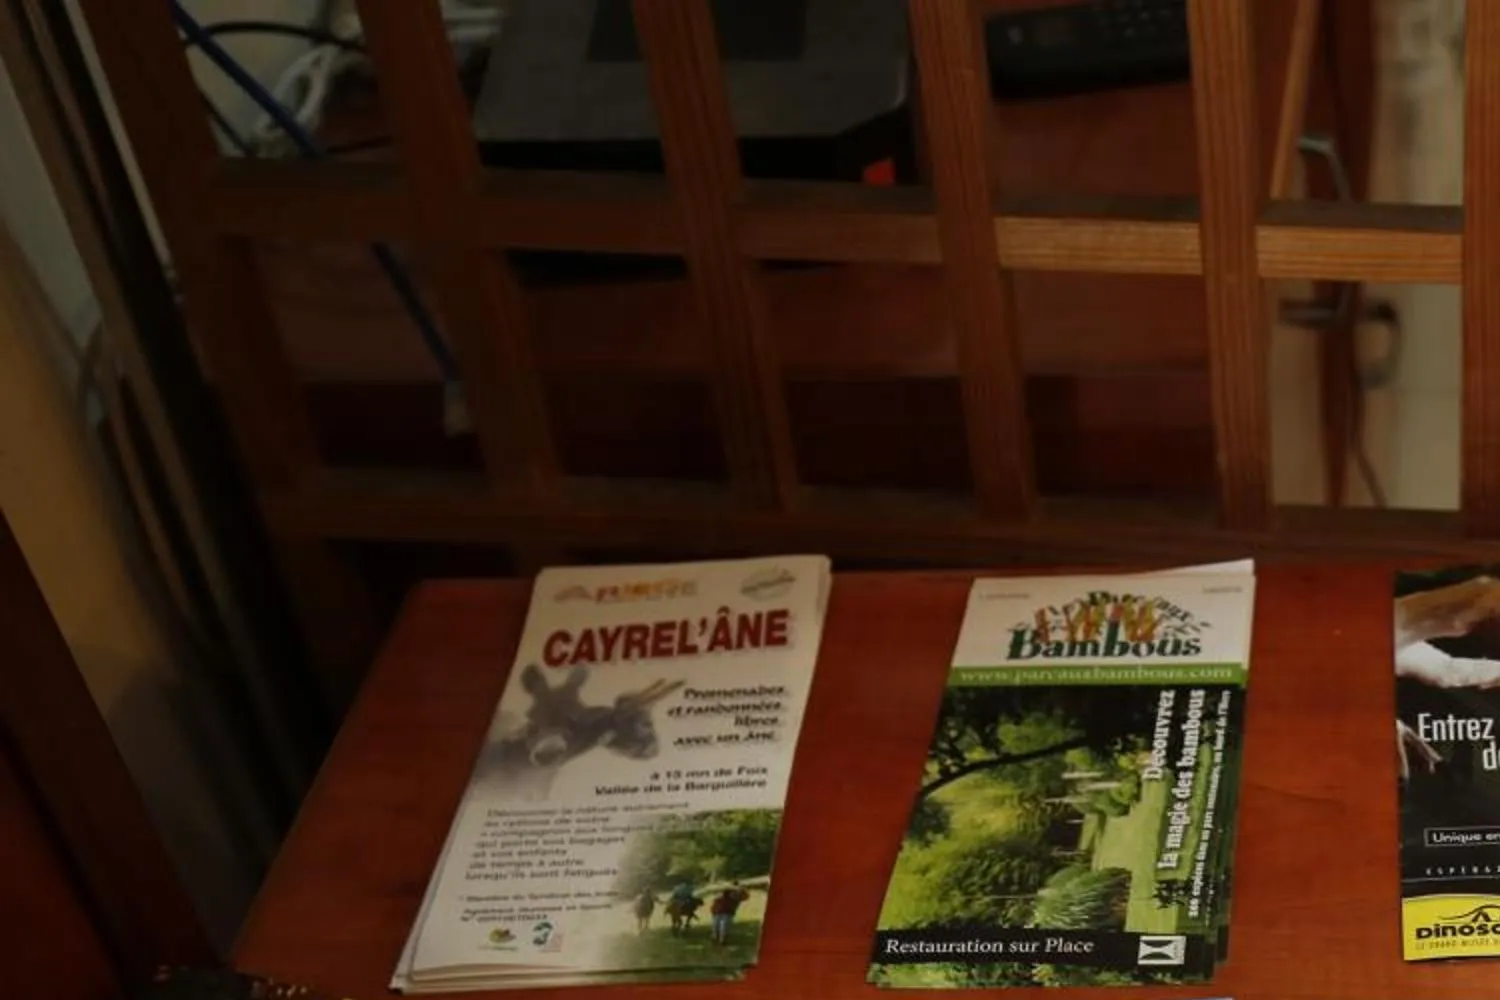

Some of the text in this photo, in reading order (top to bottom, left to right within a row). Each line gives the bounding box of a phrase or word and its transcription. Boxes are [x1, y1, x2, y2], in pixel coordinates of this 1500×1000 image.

[543, 605, 789, 667] CAYREL'ÂNE
[1005, 619, 1202, 660] Bambous
[1175, 689, 1205, 767] bambous
[1417, 713, 1495, 742] Entrez
[1171, 771, 1194, 799] des
[1165, 801, 1191, 849] magie
[1432, 831, 1483, 844] Unique
[886, 936, 1095, 954] Restauration sur Place
